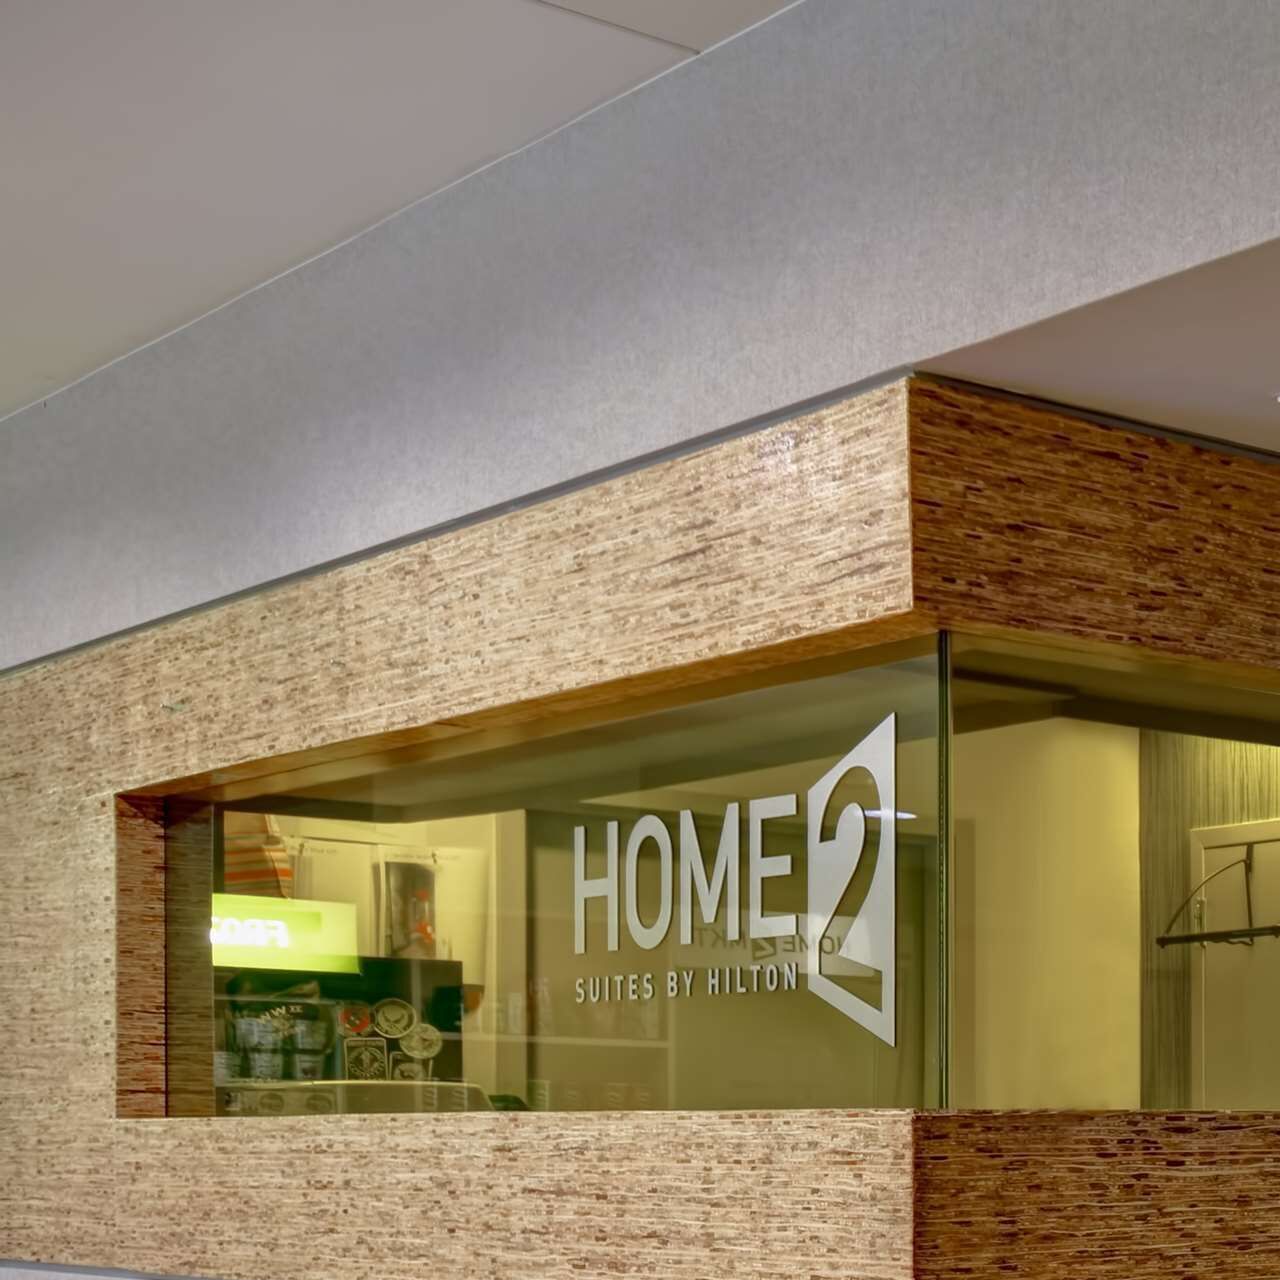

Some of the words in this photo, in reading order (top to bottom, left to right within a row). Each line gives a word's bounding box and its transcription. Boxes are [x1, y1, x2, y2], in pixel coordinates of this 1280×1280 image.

[575, 972, 654, 1004] SUITES
[667, 969, 694, 998] BY
[708, 962, 799, 995] HILTON
